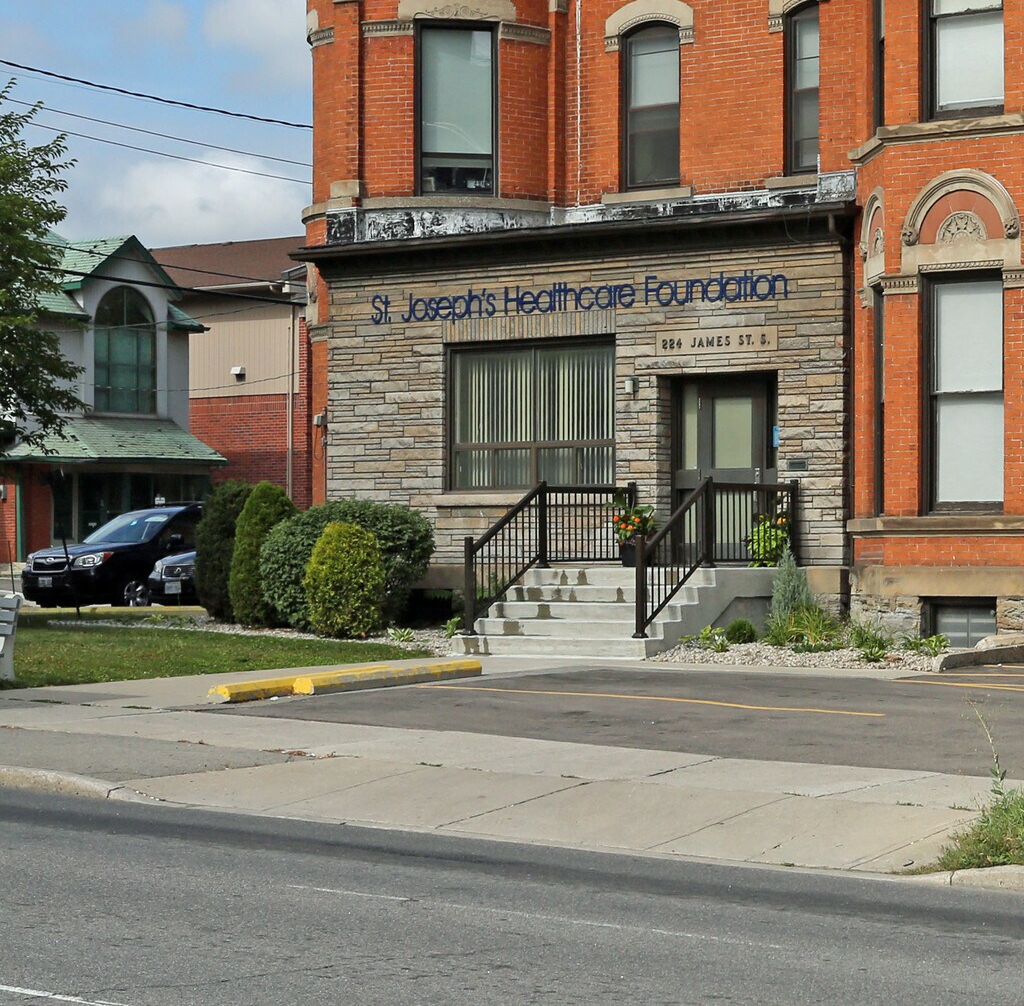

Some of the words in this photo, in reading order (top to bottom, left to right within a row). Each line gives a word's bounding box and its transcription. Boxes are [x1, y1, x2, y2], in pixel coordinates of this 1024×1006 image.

[371, 294, 392, 324] St.
[401, 288, 496, 325] Joseph's
[504, 281, 635, 315] Healthcare
[644, 271, 788, 306] Foundation
[661, 337, 682, 350] 224
[690, 334, 731, 349] JAMES
[738, 334, 755, 346] ST.
[760, 334, 771, 345] S.
